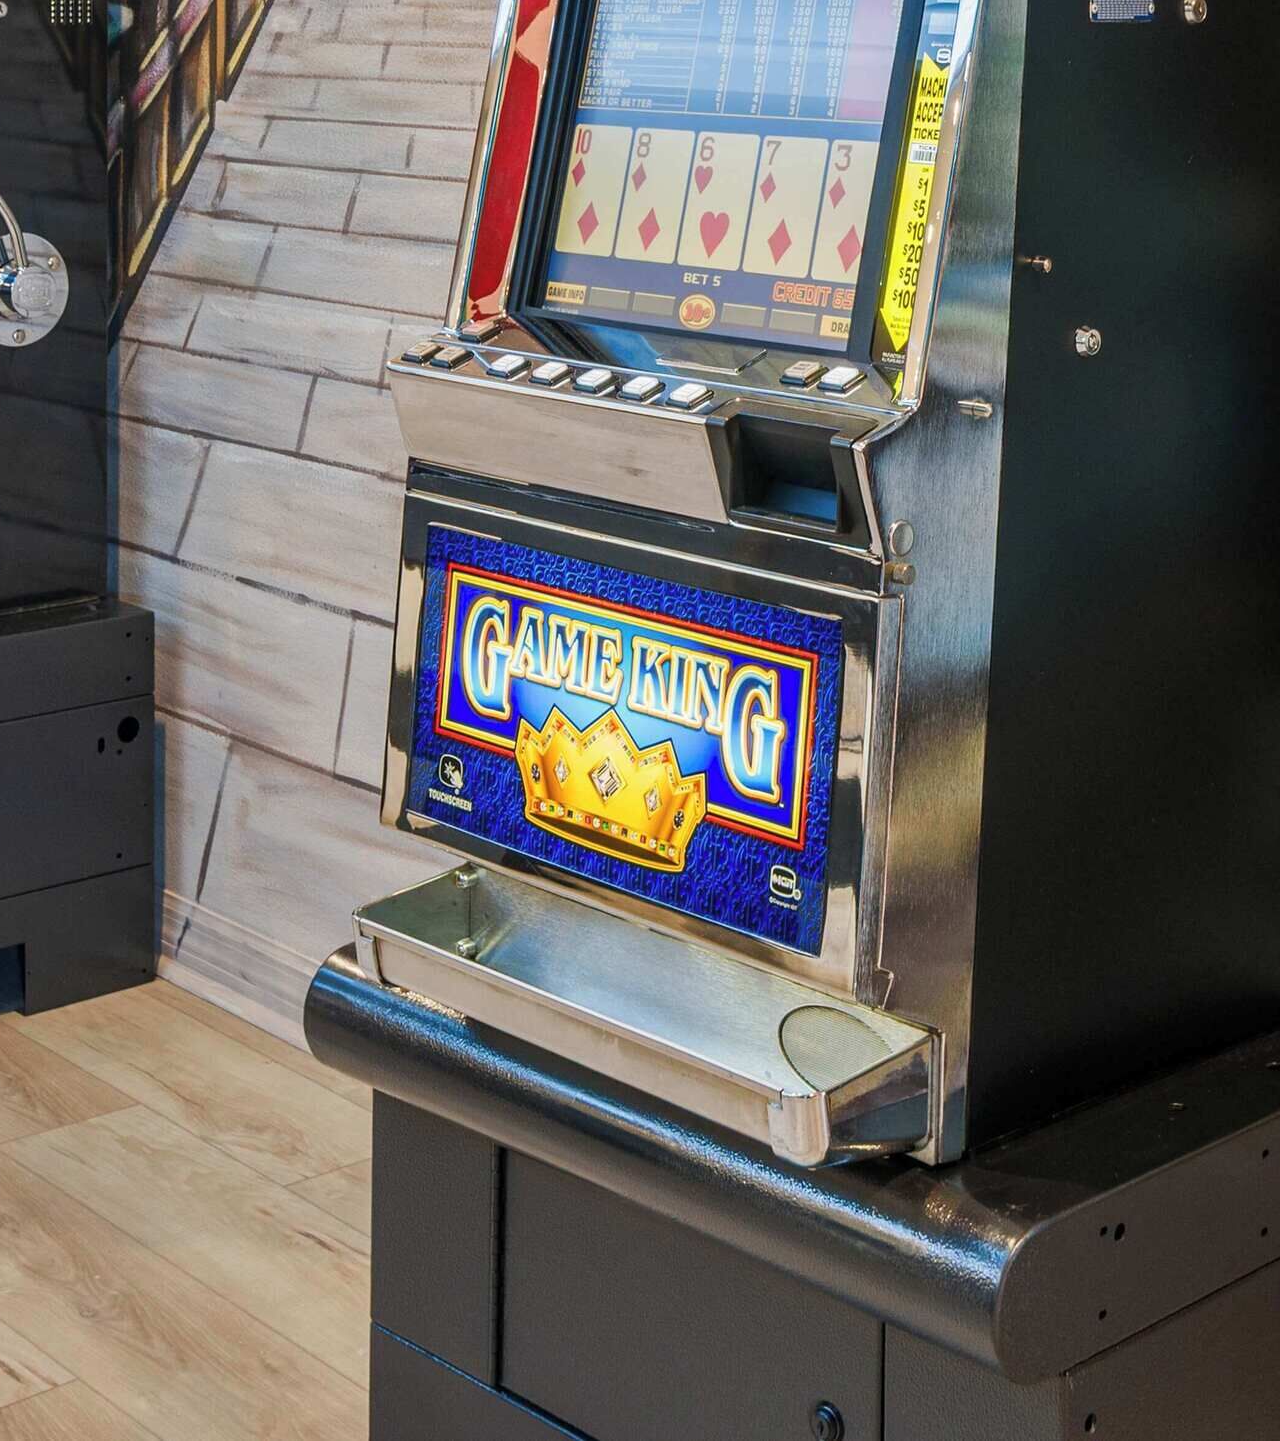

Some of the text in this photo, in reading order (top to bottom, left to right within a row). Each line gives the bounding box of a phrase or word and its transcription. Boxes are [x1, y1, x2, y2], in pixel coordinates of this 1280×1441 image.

[754, 7, 773, 15] 500
[825, 8, 850, 16] 1000
[754, 16, 772, 25] 100
[829, 18, 848, 26] 200
[826, 48, 843, 56] 100
[582, 97, 606, 105] JACKS
[621, 98, 652, 108] BETTER
[575, 128, 592, 156] 10
[636, 132, 652, 158] 8
[700, 136, 716, 162] 6
[766, 140, 782, 166] 7
[835, 144, 852, 171] 3
[917, 177, 929, 197] $1
[912, 199, 926, 218] $5
[906, 221, 925, 241] $10
[902, 243, 923, 264] $20
[682, 271, 722, 288] BET 5
[898, 266, 919, 286] $50
[548, 286, 584, 301] GAME INFO
[772, 280, 831, 307] CREDIT
[463, 596, 785, 805] GAME KING
[428, 787, 473, 812] TOUCHSCREEN
